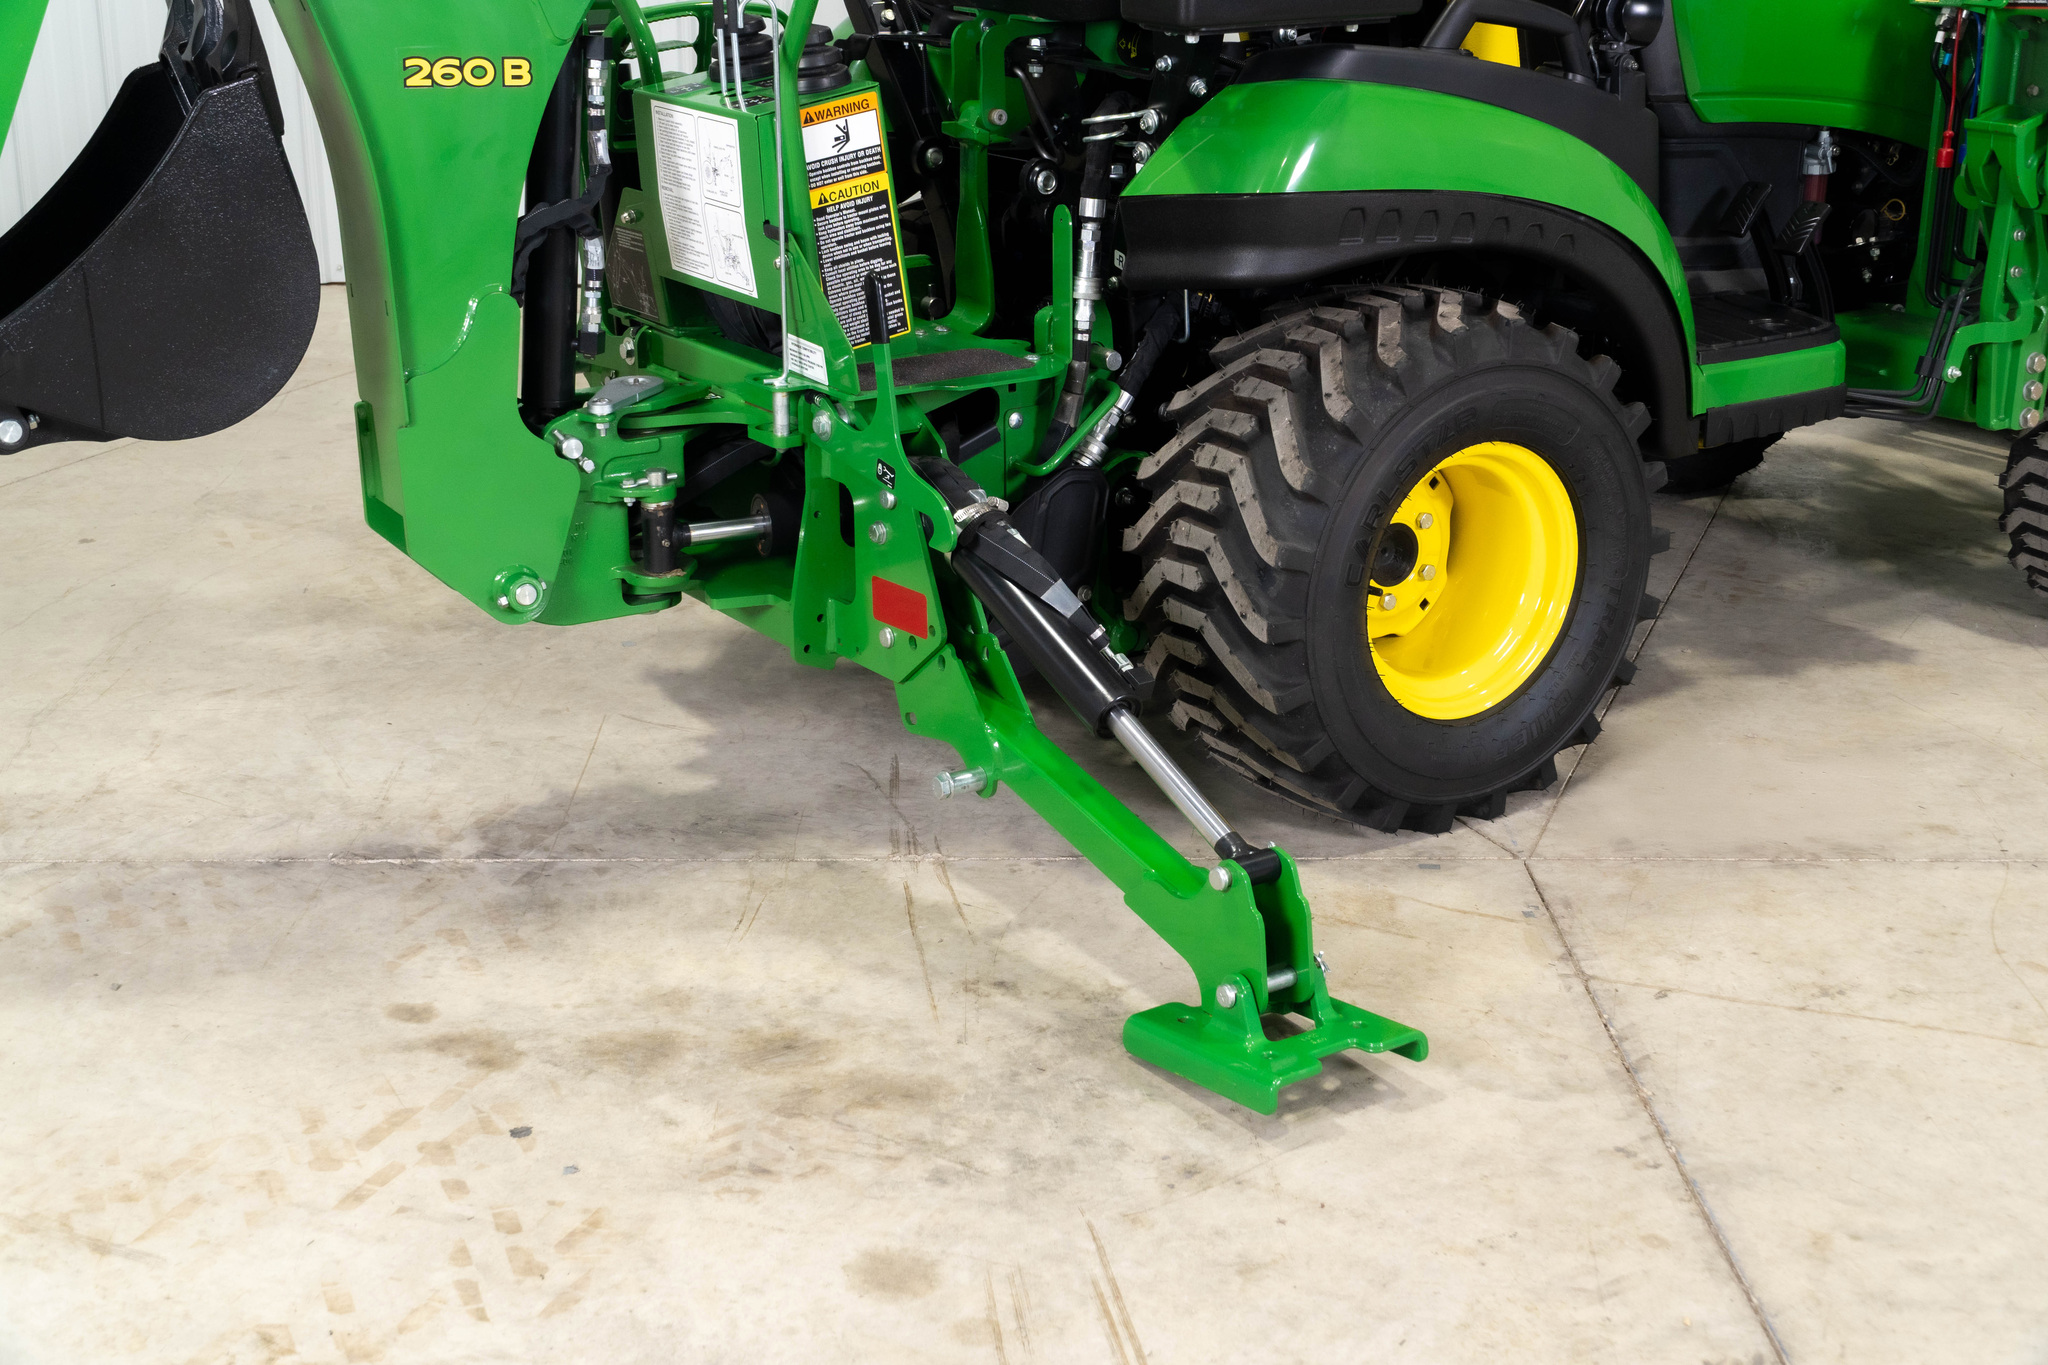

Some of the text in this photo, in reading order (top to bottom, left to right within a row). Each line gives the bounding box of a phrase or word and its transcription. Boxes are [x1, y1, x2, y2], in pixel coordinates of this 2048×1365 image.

[403, 56, 533, 88] 260 B
[814, 99, 870, 121] WARNING
[821, 157, 838, 167] CRUSH
[839, 152, 857, 162] INJURY
[857, 150, 865, 158] OR
[865, 146, 881, 155] DEATH
[826, 195, 874, 213] HELP AVOID INJURY
[829, 181, 880, 202] CAUTION
[1344, 406, 1479, 588] CARLSTAR
[1581, 579, 1623, 677] TRAC
[1494, 688, 1572, 761] CHIEF
